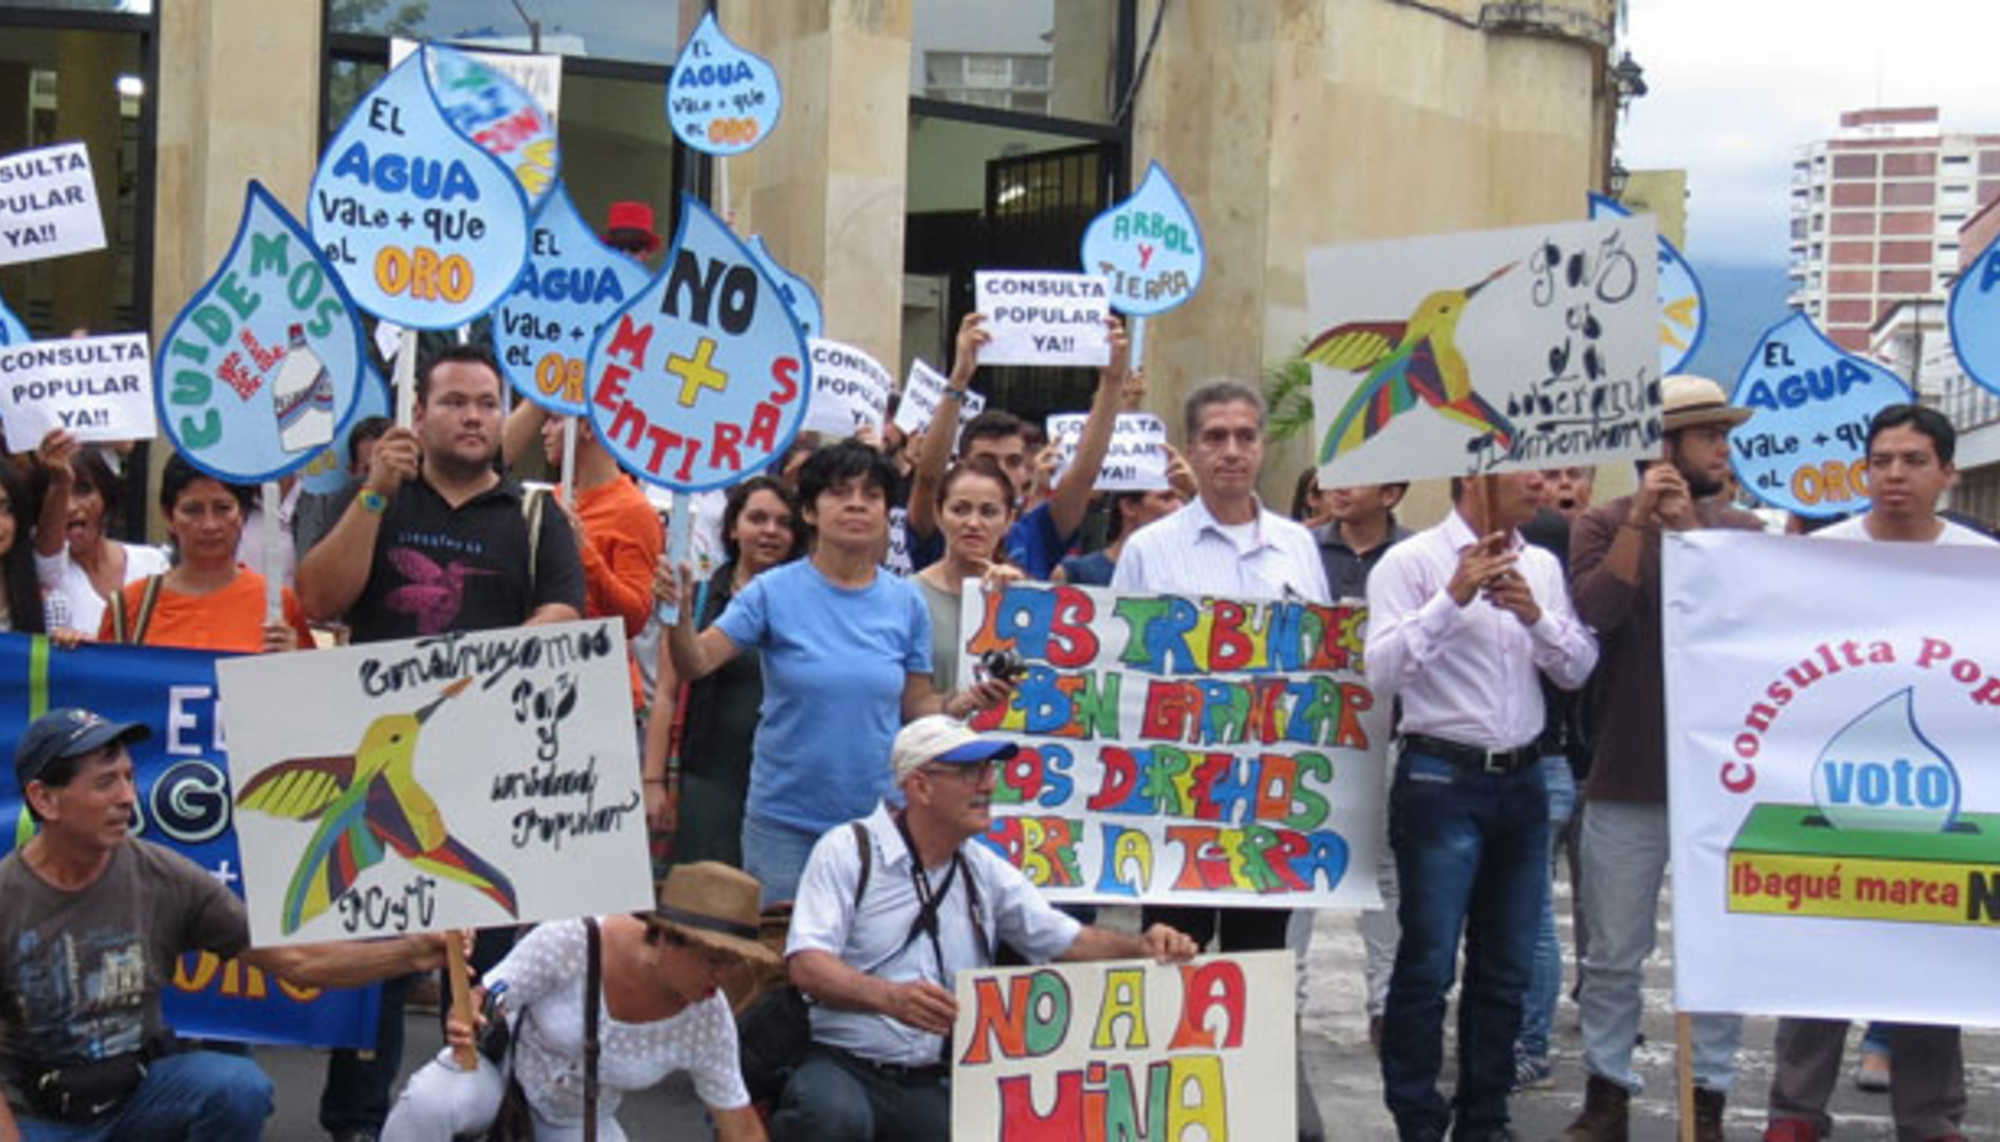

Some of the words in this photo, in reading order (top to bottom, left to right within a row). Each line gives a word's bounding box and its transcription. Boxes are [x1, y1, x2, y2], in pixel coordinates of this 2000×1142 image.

[678, 60, 754, 88] AGUA
[369, 97, 405, 136] EL
[708, 117, 758, 146] ORO
[332, 141, 480, 202] AGUA
[4, 225, 57, 247] YA!!
[533, 229, 561, 256] EL
[374, 245, 474, 304] ORO
[512, 262, 624, 304] AGUA
[660, 247, 758, 335] NO
[985, 279, 1106, 298] CONSULTA
[994, 306, 1101, 324] POPULAR
[1, 342, 146, 373] CONSULTA
[169, 232, 344, 451] CUIDEMOS
[1033, 336, 1075, 352] YA!!
[1764, 341, 1795, 368] EL
[12, 375, 140, 404] POPULAR
[664, 336, 729, 409] +
[1746, 358, 1872, 411] AGUA
[58, 409, 109, 428] YA!!
[967, 585, 1100, 669] LOS
[1720, 639, 1895, 794] Consulta
[1087, 744, 1334, 830] DERECHOS
[1823, 758, 1950, 808] voto
[1095, 823, 1153, 897] LA
[1732, 862, 1843, 911] Ibagué
[1855, 876, 1960, 907] marca
[960, 969, 1071, 1066] NO
[1091, 968, 1149, 1049] A
[1169, 961, 1247, 1050] LA
